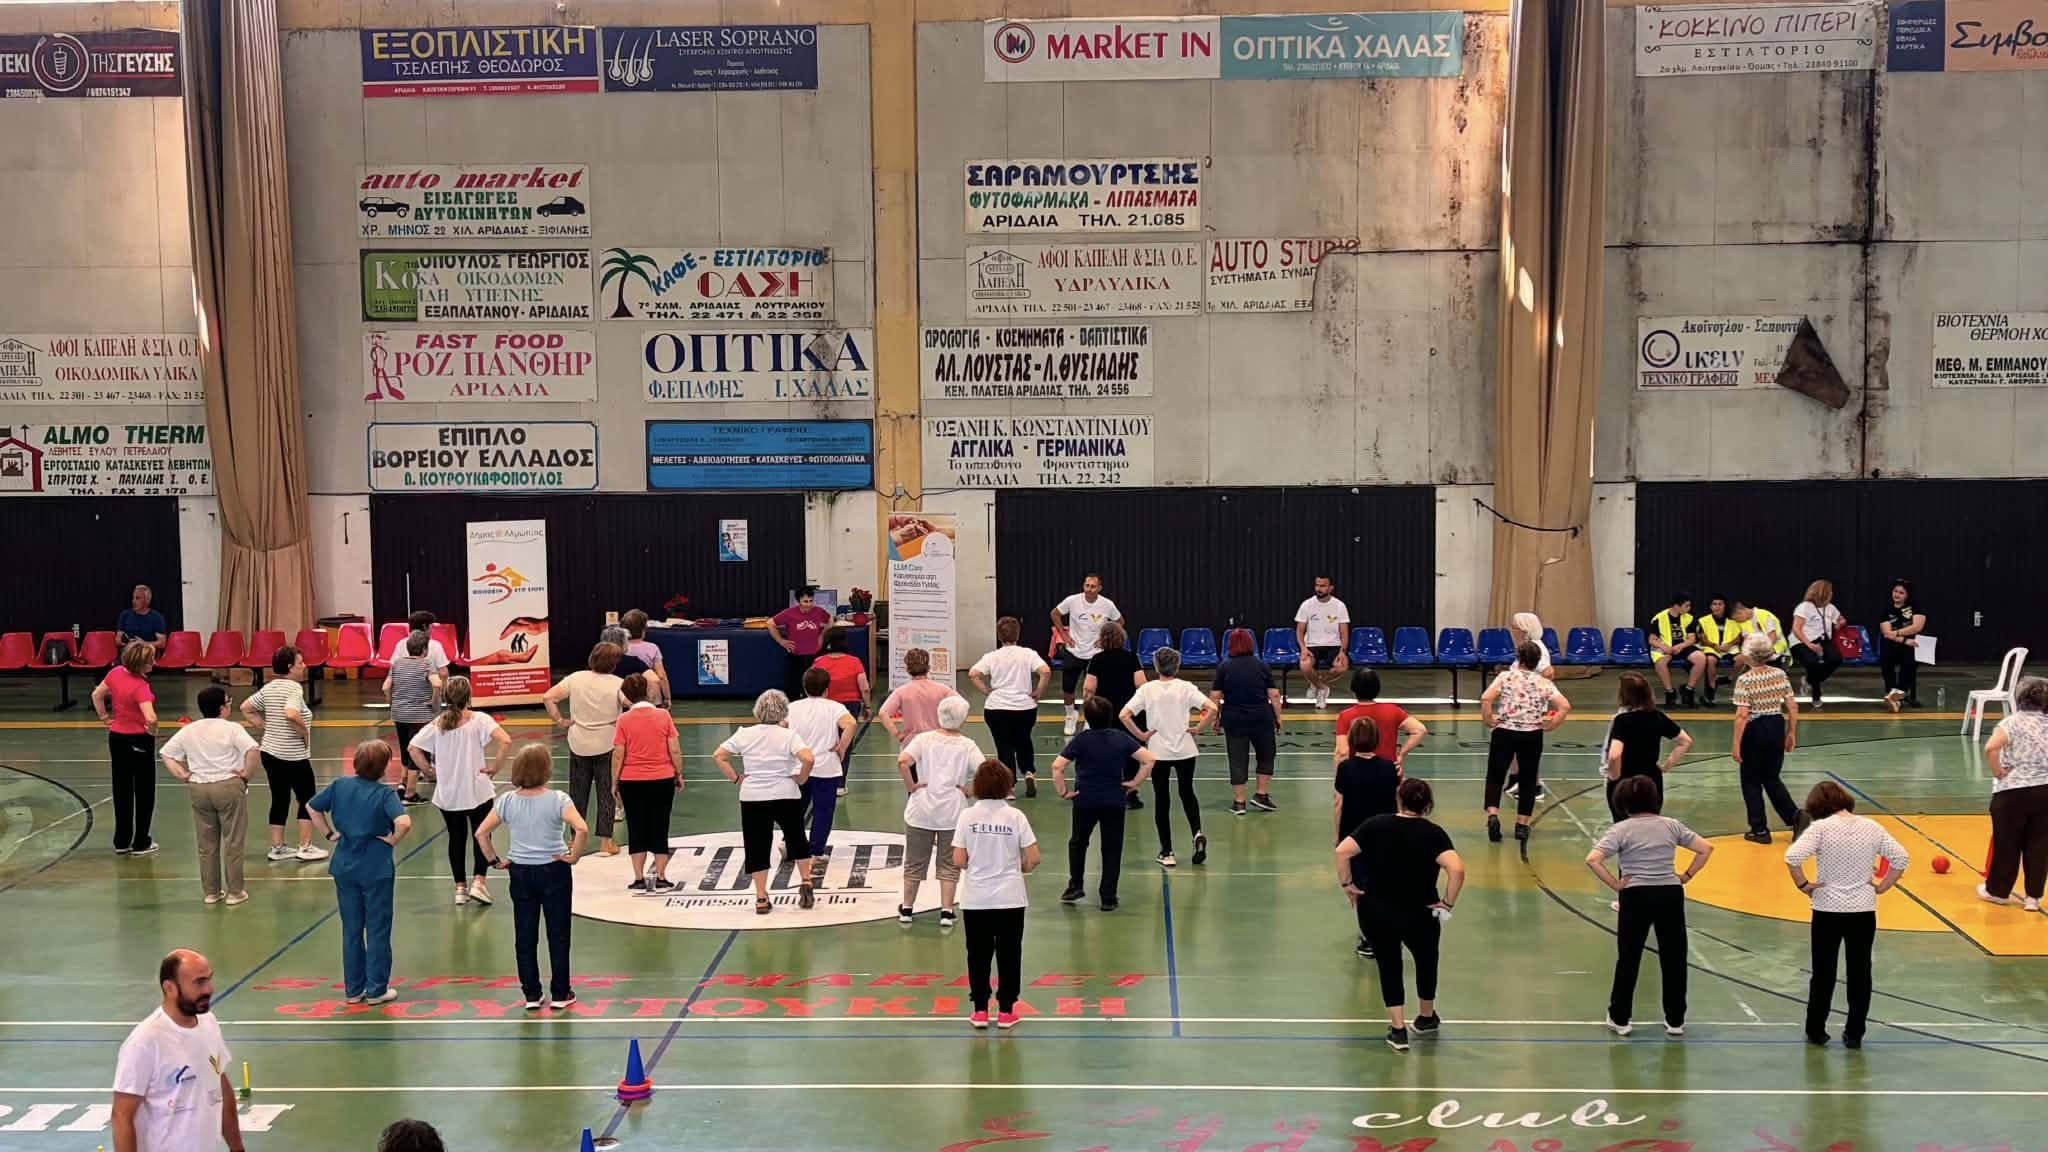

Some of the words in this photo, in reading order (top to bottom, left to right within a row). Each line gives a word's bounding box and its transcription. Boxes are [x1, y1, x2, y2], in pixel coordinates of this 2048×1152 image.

[1659, 15, 1765, 39] ΚΟΚΚΙΝΟ
[1775, 12, 1857, 33] ΠΙΠΕΡΙ
[373, 28, 585, 59] ΕΞΟΠΛΙΣΤΙΚΗ
[655, 29, 715, 47] LASER
[720, 28, 815, 47] SOPRANO
[1181, 31, 1211, 58] IN
[1233, 35, 1345, 60] ΟΠΤΙΚΑ
[1353, 34, 1451, 58] ΧΑΛΑΣ
[1694, 45, 1825, 58] ΕΣΤΙΑΤΟΡΙΟ
[392, 60, 473, 76] ΤΣΕΛΕΠΗΣ
[478, 58, 565, 74] ΘΕΟΔΩΡΟΣ
[360, 169, 441, 189] auto
[453, 167, 585, 189] market
[967, 163, 1199, 186] ΣΑΡΑΜΟΥΡΤΣΗΣ
[424, 191, 518, 205] ΕΙΣΑΓΩΓΕΣ
[969, 190, 1089, 209] ΦΥΤΟΦΑΡΜΑΚΑ
[1106, 189, 1198, 208] ΛΙΠΑΣΜΑΤΑ
[414, 206, 533, 221] ΑΥΤΟΚΙΝΗΤΩΝ
[982, 214, 1059, 227] ΑΡΙΔΑΙΑ
[1079, 214, 1120, 227] ΤΗΛ.
[1127, 213, 1185, 226] 21.085
[361, 225, 381, 236] ΧΡ.
[388, 224, 431, 236] ΜΗΝΟΣ
[478, 225, 528, 235] ΑΡΙΔΑΙΑΣ
[508, 253, 589, 268] ΓΕΩΡΓΙΟΣ
[713, 249, 827, 267] ΕΣΤΙΑΤΟΡΙΟ
[1037, 249, 1069, 269] ΑΦΟΙ
[1074, 248, 1128, 268] ΚΑΠΕΛΗ
[1210, 240, 1268, 272] AUTO
[457, 271, 564, 286] ΟΙΚΟΔΟΜΩΝ
[697, 271, 813, 298] ΟΑΣΗ
[1054, 276, 1171, 292] ΥΔΡΑΥΛΙΚΑ
[1210, 271, 1276, 286] ΣΥΣΤΗΜΑΤΑ
[425, 305, 519, 318] ΕΞΑΠΛΑΤΑΝΟΥ
[529, 305, 589, 318] ΑΡΙΔΑΙΑΣ
[689, 301, 741, 310] ΑΡΙΔΑΙΑΣ
[755, 301, 825, 310] ΛΟΥΤΡΑΚΙΟΥ
[691, 311, 709, 319] 22
[716, 311, 743, 319] 471
[768, 311, 787, 319] 22
[1936, 314, 2009, 328] ΒΙΟΤΕΧΝΙΑ
[415, 334, 478, 349] FAST
[494, 334, 564, 349] FOOD
[996, 328, 1065, 348] ΚΟΣΜΗΜΑΤΑ
[1080, 326, 1148, 347] ΒΑΠΤΙΣΤΙΚΑ
[84, 337, 136, 357] ΚΑΠΕΛΗ
[645, 332, 870, 373] ΟΠΤΙΚΑ
[394, 351, 454, 376] ΡΟΖ
[464, 351, 592, 376] ΠΑΝΘΗΡ
[55, 366, 150, 381] ΟΙΚΟΔΟΜΙΚΑ
[154, 366, 198, 381] ΥΛΙΚΑ
[1642, 372, 1688, 385] ΤΕΧΝΙΚΟ
[1691, 372, 1738, 385] ΓΡΑΦΕΙΟ
[450, 382, 549, 396] ΑΡΙΔΑΙΑ
[792, 378, 869, 398] ΧΑΛΑΣ
[945, 385, 968, 397] ΚΕΝ.
[971, 385, 1014, 397] ΠΛΑΤΕΙΑ
[1016, 384, 1063, 396] ΑΡΙΔΑΙΑΣ
[1068, 384, 1091, 396] ΤΗΛ.
[44, 425, 110, 444] ALMO
[125, 425, 205, 444] THERM
[1012, 418, 1151, 437] ΚΩΝΣΤΑΝΤΙΝΙΔΟΥ
[438, 427, 526, 446] ΕΠΙΠΛΟ
[48, 447, 82, 456] ΛΕΒΗΤΕΣ
[951, 439, 1015, 457] ΑΓΓΛΙΚΑ
[1036, 438, 1126, 456] ΓΕΡΜΑΝΙΚΑ
[44, 460, 100, 471] ΕΡΓΟΣΤΑΣΙΟ
[106, 459, 164, 471] ΚΑΤΑΣΚΕΥΕΣ
[168, 459, 211, 470] ΛΕΒΗΤΩΝ
[372, 450, 468, 468] ΒΟΡΕΙΟΥ
[479, 449, 594, 467] ΕΛΛΑΔΟΣ
[756, 456, 803, 464] ΚΑΤΑΣΚΕΥΕΣ
[119, 474, 164, 485] ΠΑΥΛΙΔΗΣ
[956, 474, 1019, 485] ΑΡΙΔΑΙΑ
[1037, 473, 1072, 485] ΤΗΛ.
[1099, 473, 1121, 484] 242
[252, 975, 634, 991] SPER
[1351, 1100, 1646, 1129] club
